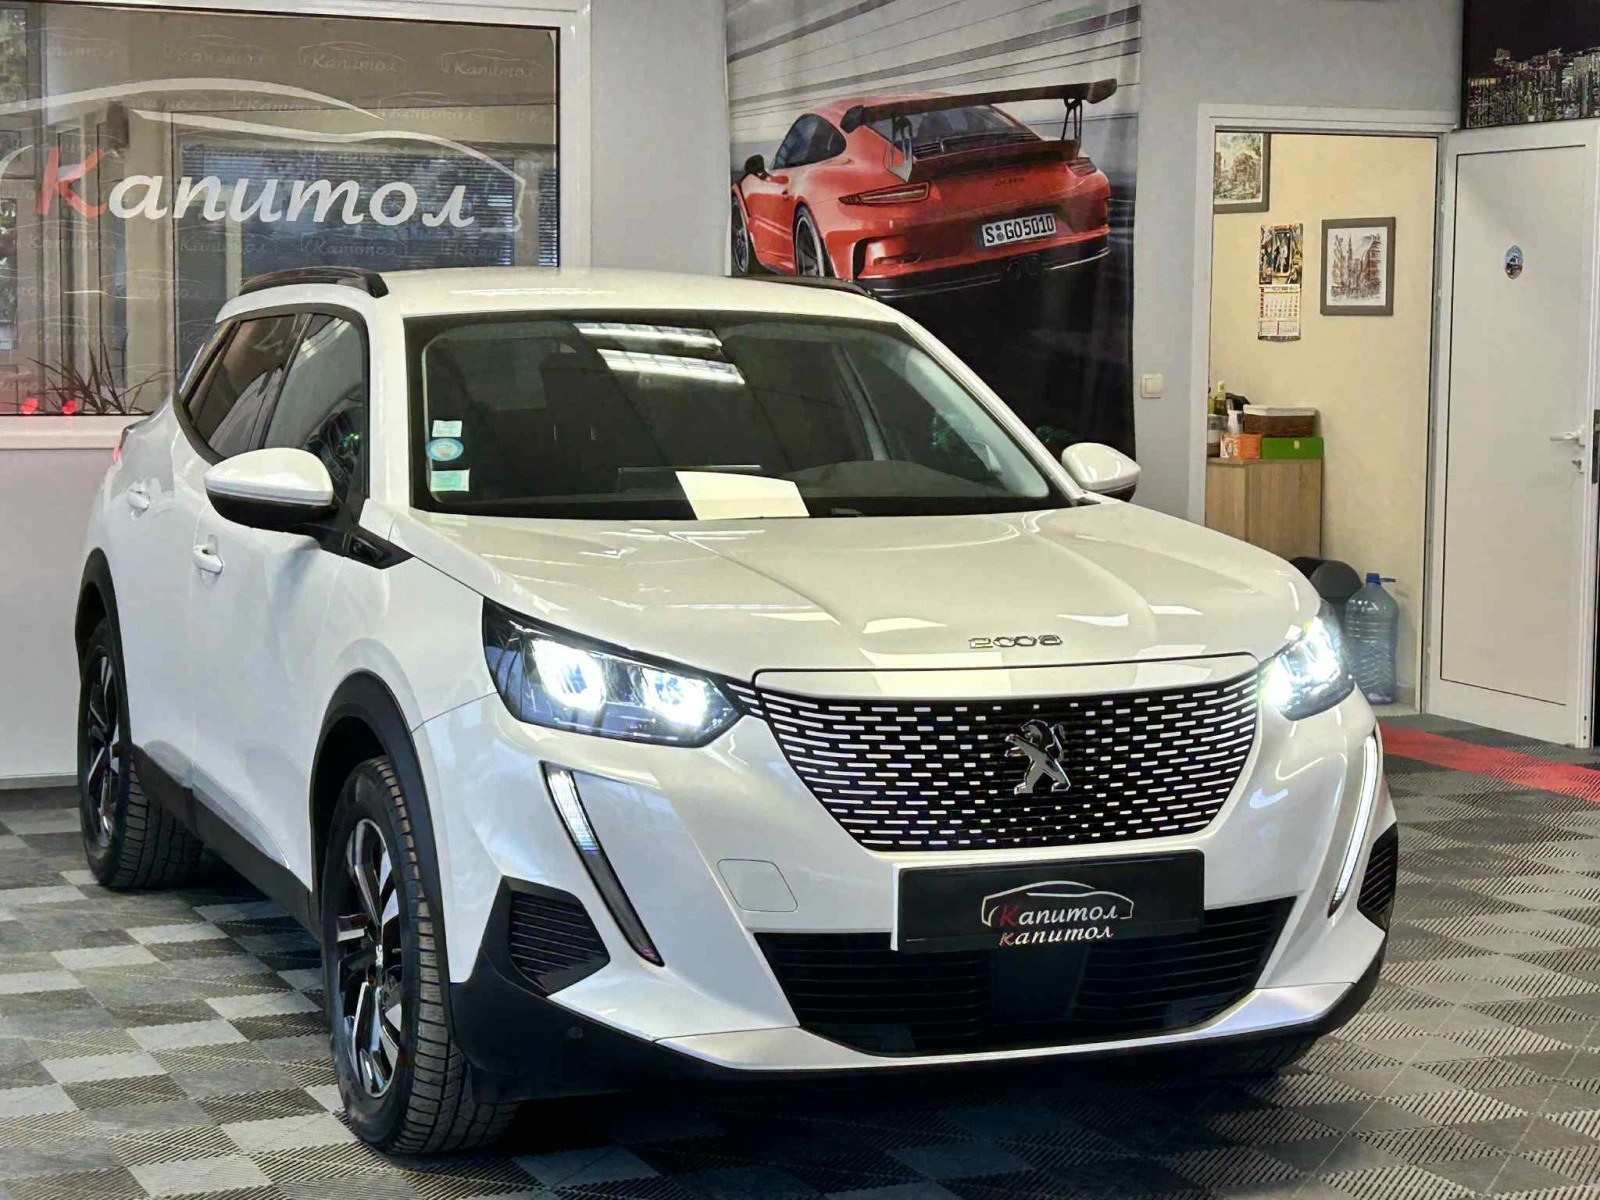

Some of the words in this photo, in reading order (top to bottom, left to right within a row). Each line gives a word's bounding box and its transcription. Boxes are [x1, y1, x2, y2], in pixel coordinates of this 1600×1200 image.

[37, 147, 475, 228] Капитол
[968, 634, 1063, 649] 2008
[1000, 904, 1118, 926] Капитол
